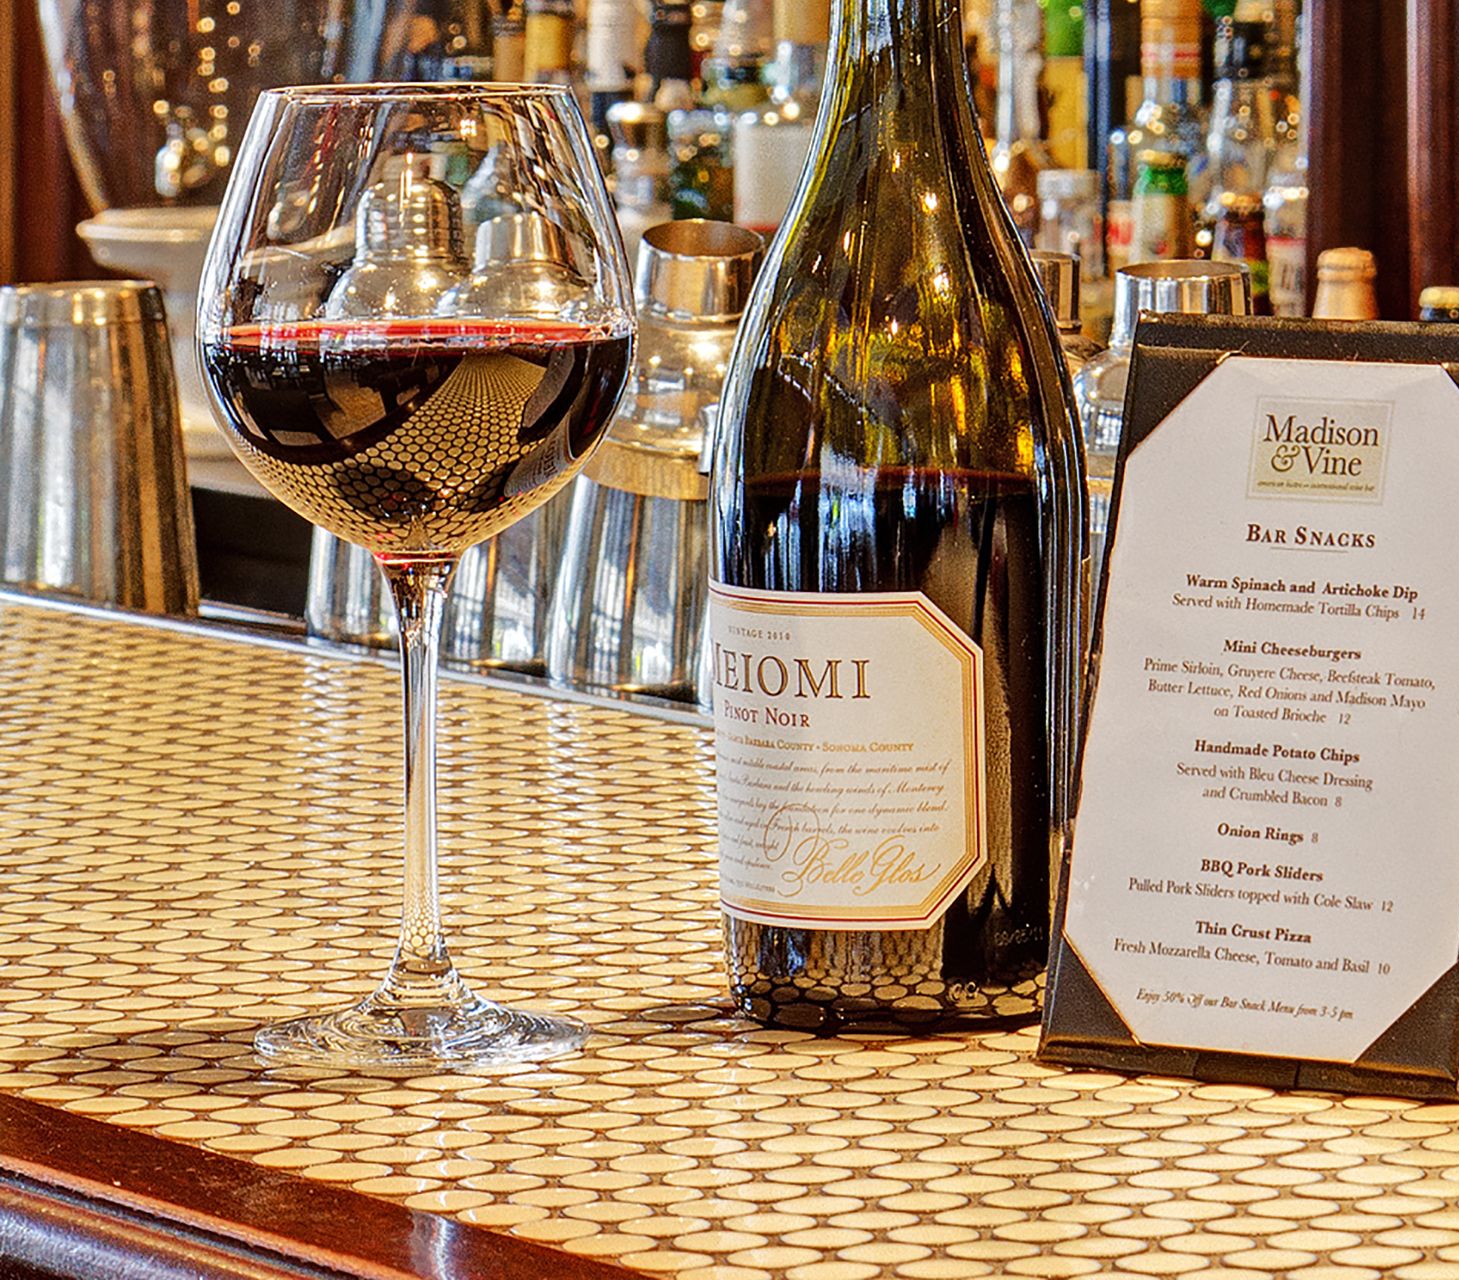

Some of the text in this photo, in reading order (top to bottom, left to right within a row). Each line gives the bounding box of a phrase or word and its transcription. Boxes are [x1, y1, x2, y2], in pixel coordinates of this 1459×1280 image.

[1263, 414, 1379, 447] Madison
[1271, 444, 1362, 477] & Vine
[1186, 573, 1419, 604] Warm Spinach and Artichoke Dip
[1171, 592, 1426, 623] Served with Homemade Tortilla Chips 14
[728, 625, 763, 639] VINTAGE
[1222, 639, 1362, 663] Mini Cheeseburgers
[1143, 657, 1436, 691] Prime Sirloin, Gruyere Cheese, Beefsteak Tomato,
[1147, 678, 1426, 713] Butter Lettuce, Red Onions and Madison Mayo
[724, 699, 811, 728] PINOT NOIR
[1213, 704, 1352, 725] on Toasted Brioche 12
[869, 741, 914, 753] COUNTY
[1194, 738, 1360, 767] Handmade Potato Chips
[1176, 762, 1374, 793] Served with Bleu Cheese Dressing
[1201, 785, 1227, 799] and
[1228, 786, 1289, 804] Crumbled
[1291, 790, 1328, 807] Bacon
[1217, 822, 1261, 840] Onion
[1264, 826, 1305, 847] Rings
[778, 830, 940, 897] Belle Glos
[1200, 858, 1324, 883] BBQ Pork Sliders
[1128, 876, 1394, 913] Pulled Pork Sliders topped with Cole Slaw 12
[1195, 920, 1312, 944] Thin Crust Pizza
[1113, 937, 1391, 975] Fresh Mozzarella Cheese, Tomato and Basil 10
[1136, 988, 1159, 1005] Enjoy
[1221, 996, 1238, 1009] Bar
[1239, 998, 1266, 1012] Snack
[1267, 1000, 1294, 1015] Menu
[1294, 1003, 1318, 1018] from
